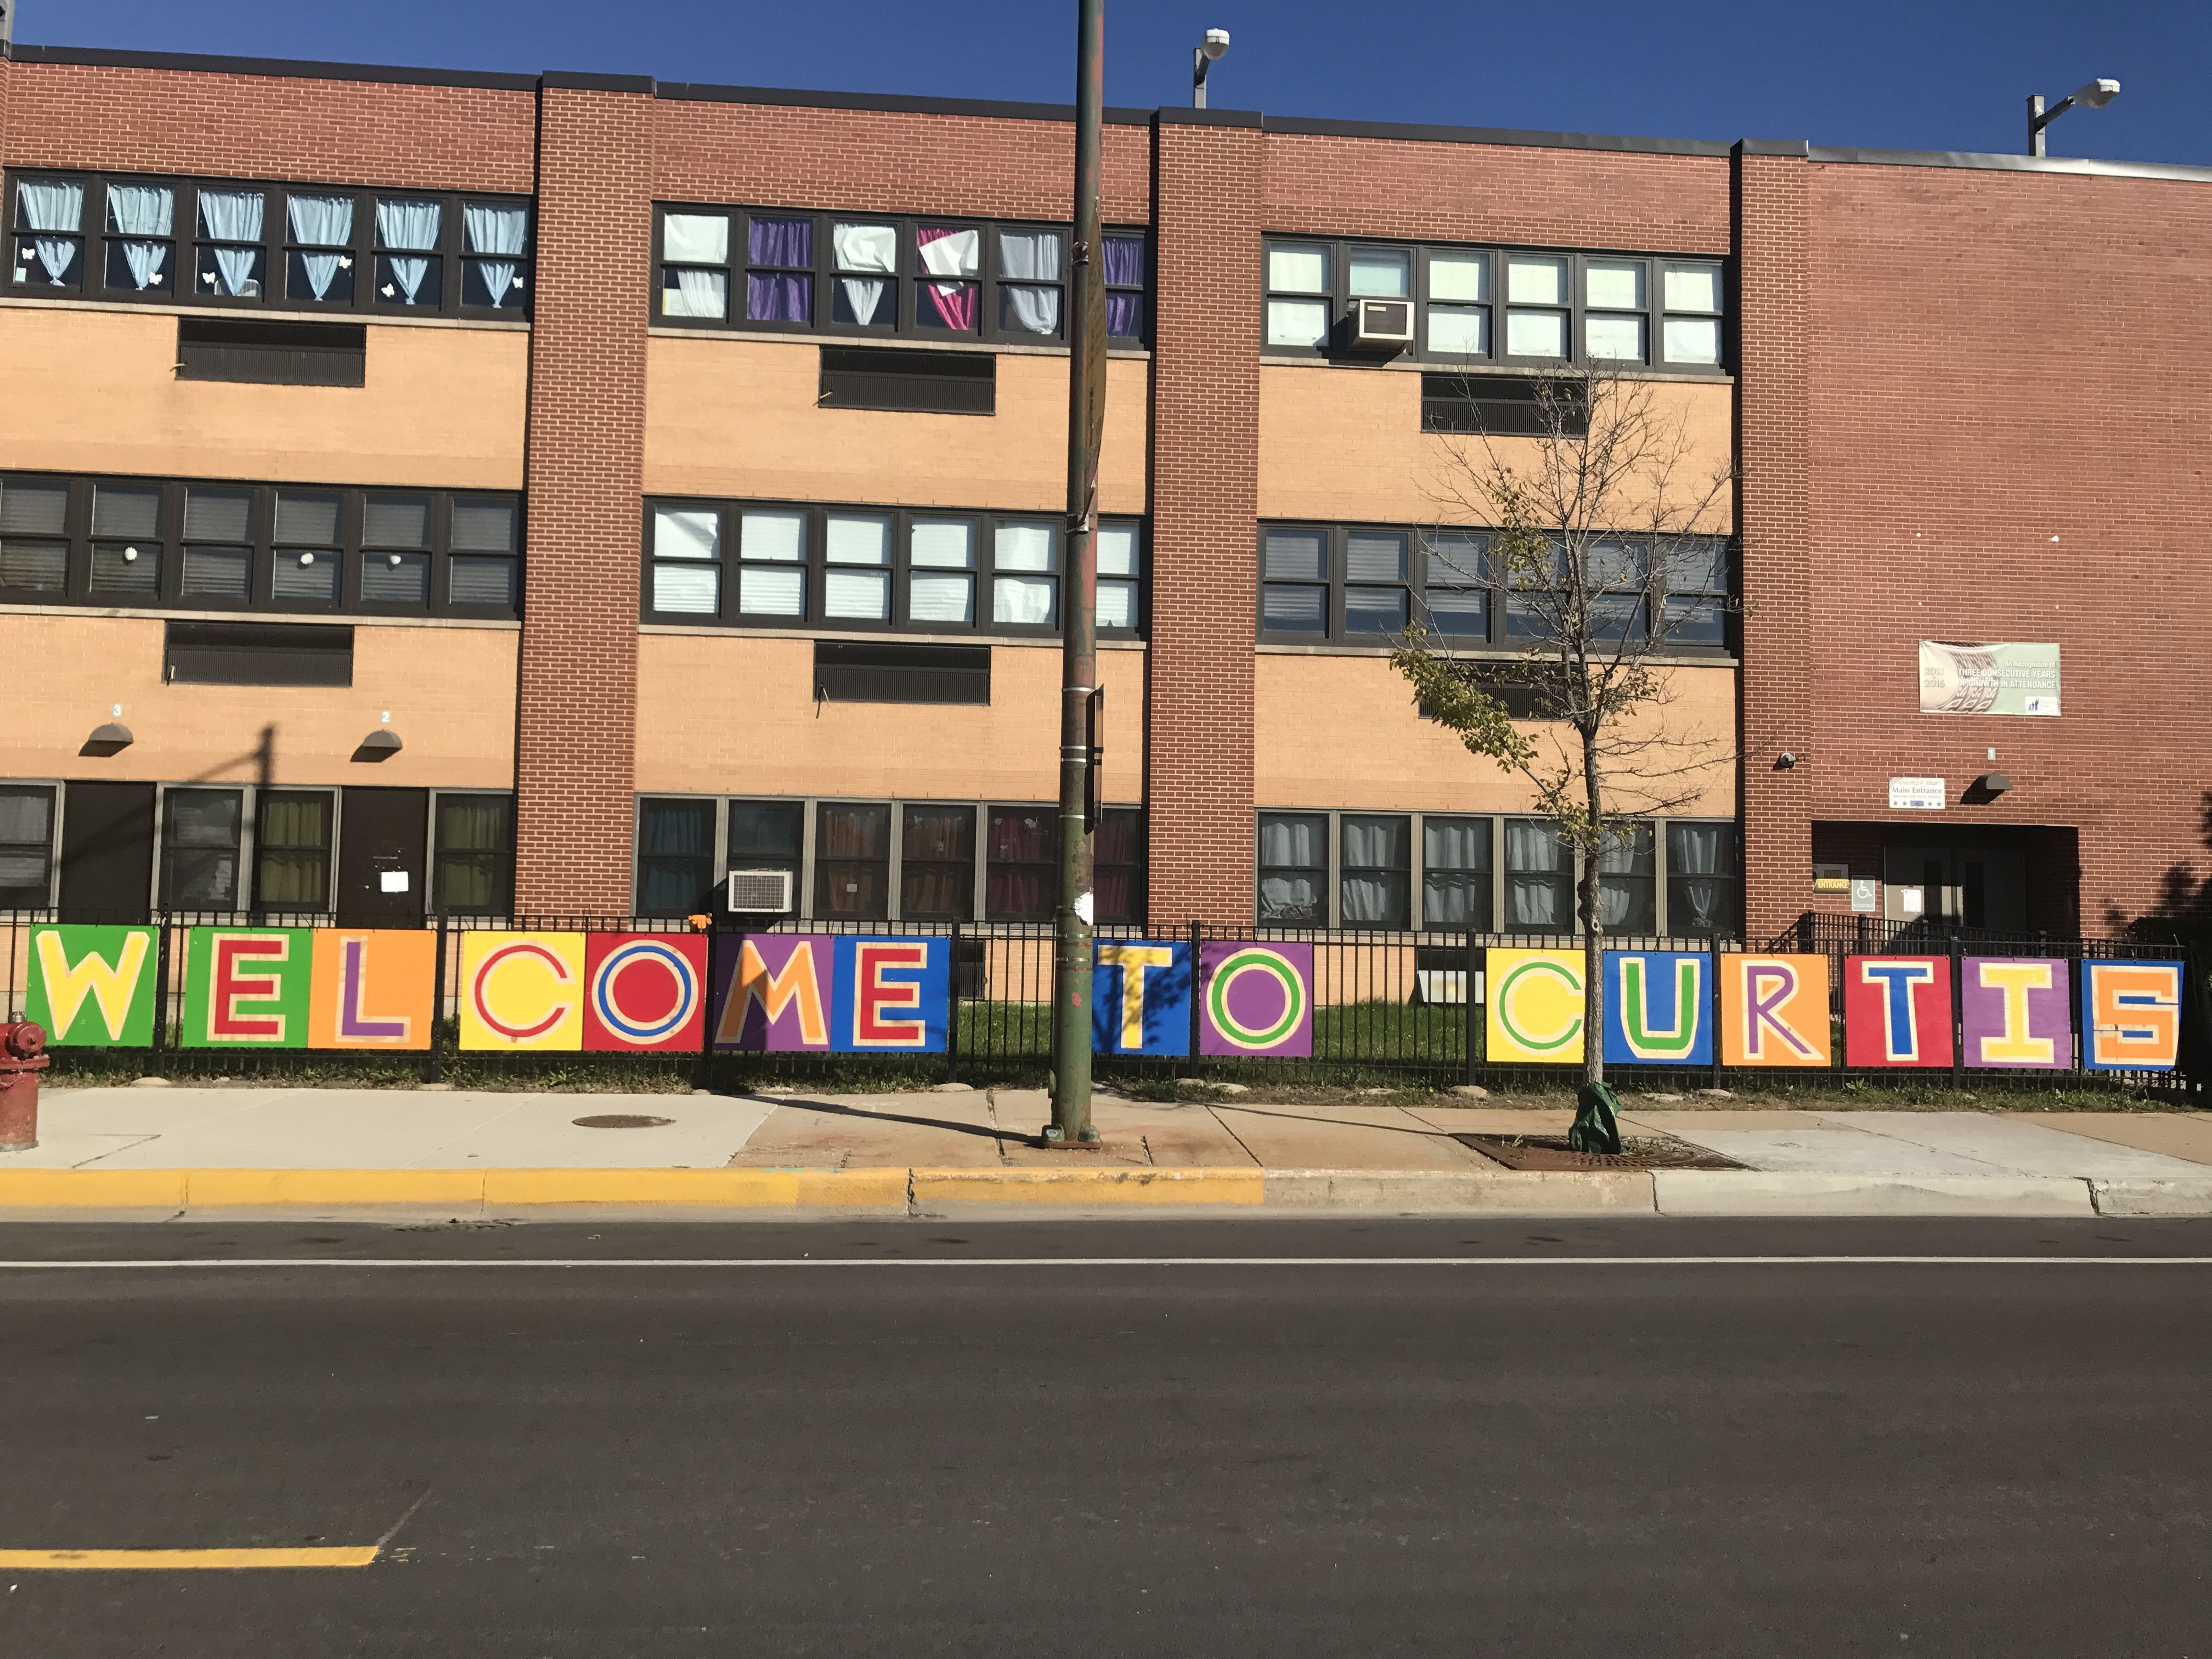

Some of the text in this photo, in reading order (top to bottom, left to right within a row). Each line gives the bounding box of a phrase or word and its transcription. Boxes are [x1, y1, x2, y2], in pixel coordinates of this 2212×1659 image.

[1958, 668, 2056, 679] THREE CONSECUTIVE YEARS
[1924, 679, 1945, 688] 2016
[1968, 679, 1999, 687] GROWTH
[2010, 680, 2056, 689] ATTENDANCE
[114, 704, 121, 716] 3
[382, 712, 390, 723] 2
[1989, 749, 1993, 758] 1
[1818, 881, 1848, 889] ENTRANCE
[36, 930, 2179, 1065] WELCOME TO CURTIS
